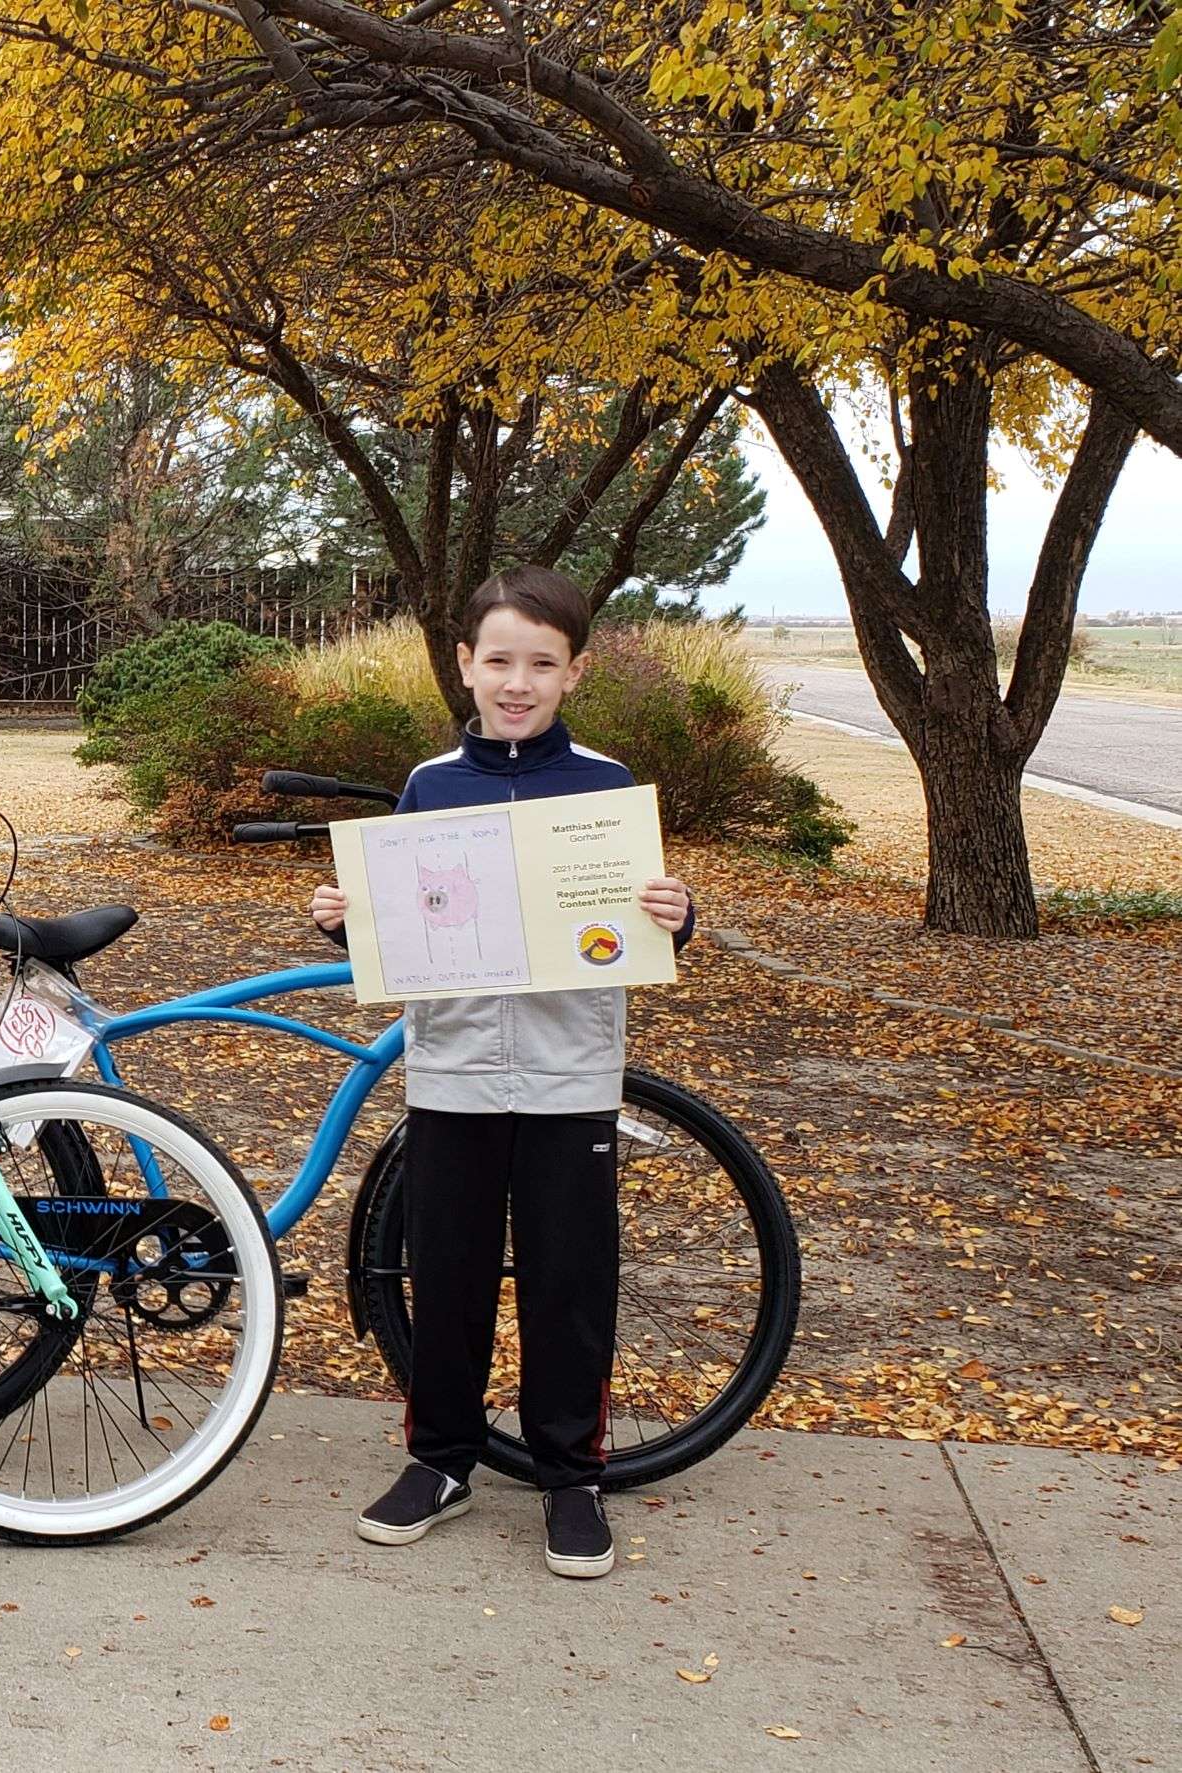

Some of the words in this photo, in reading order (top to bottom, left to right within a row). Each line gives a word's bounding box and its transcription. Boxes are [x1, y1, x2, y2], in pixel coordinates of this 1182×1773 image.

[551, 822, 593, 833] Matthias
[594, 819, 621, 829] Miller
[569, 832, 606, 843] Gorham
[552, 864, 571, 873] 2021
[573, 863, 588, 871] Put
[588, 862, 602, 870] the
[603, 859, 631, 868] Brakes
[608, 871, 625, 880] Day
[556, 888, 598, 899] Regional
[601, 885, 633, 895] Poster
[559, 899, 597, 909] Contest
[598, 896, 633, 905] Winner
[36, 1200, 142, 1215] SCHWINN
[6, 1212, 49, 1271] HUFFY
